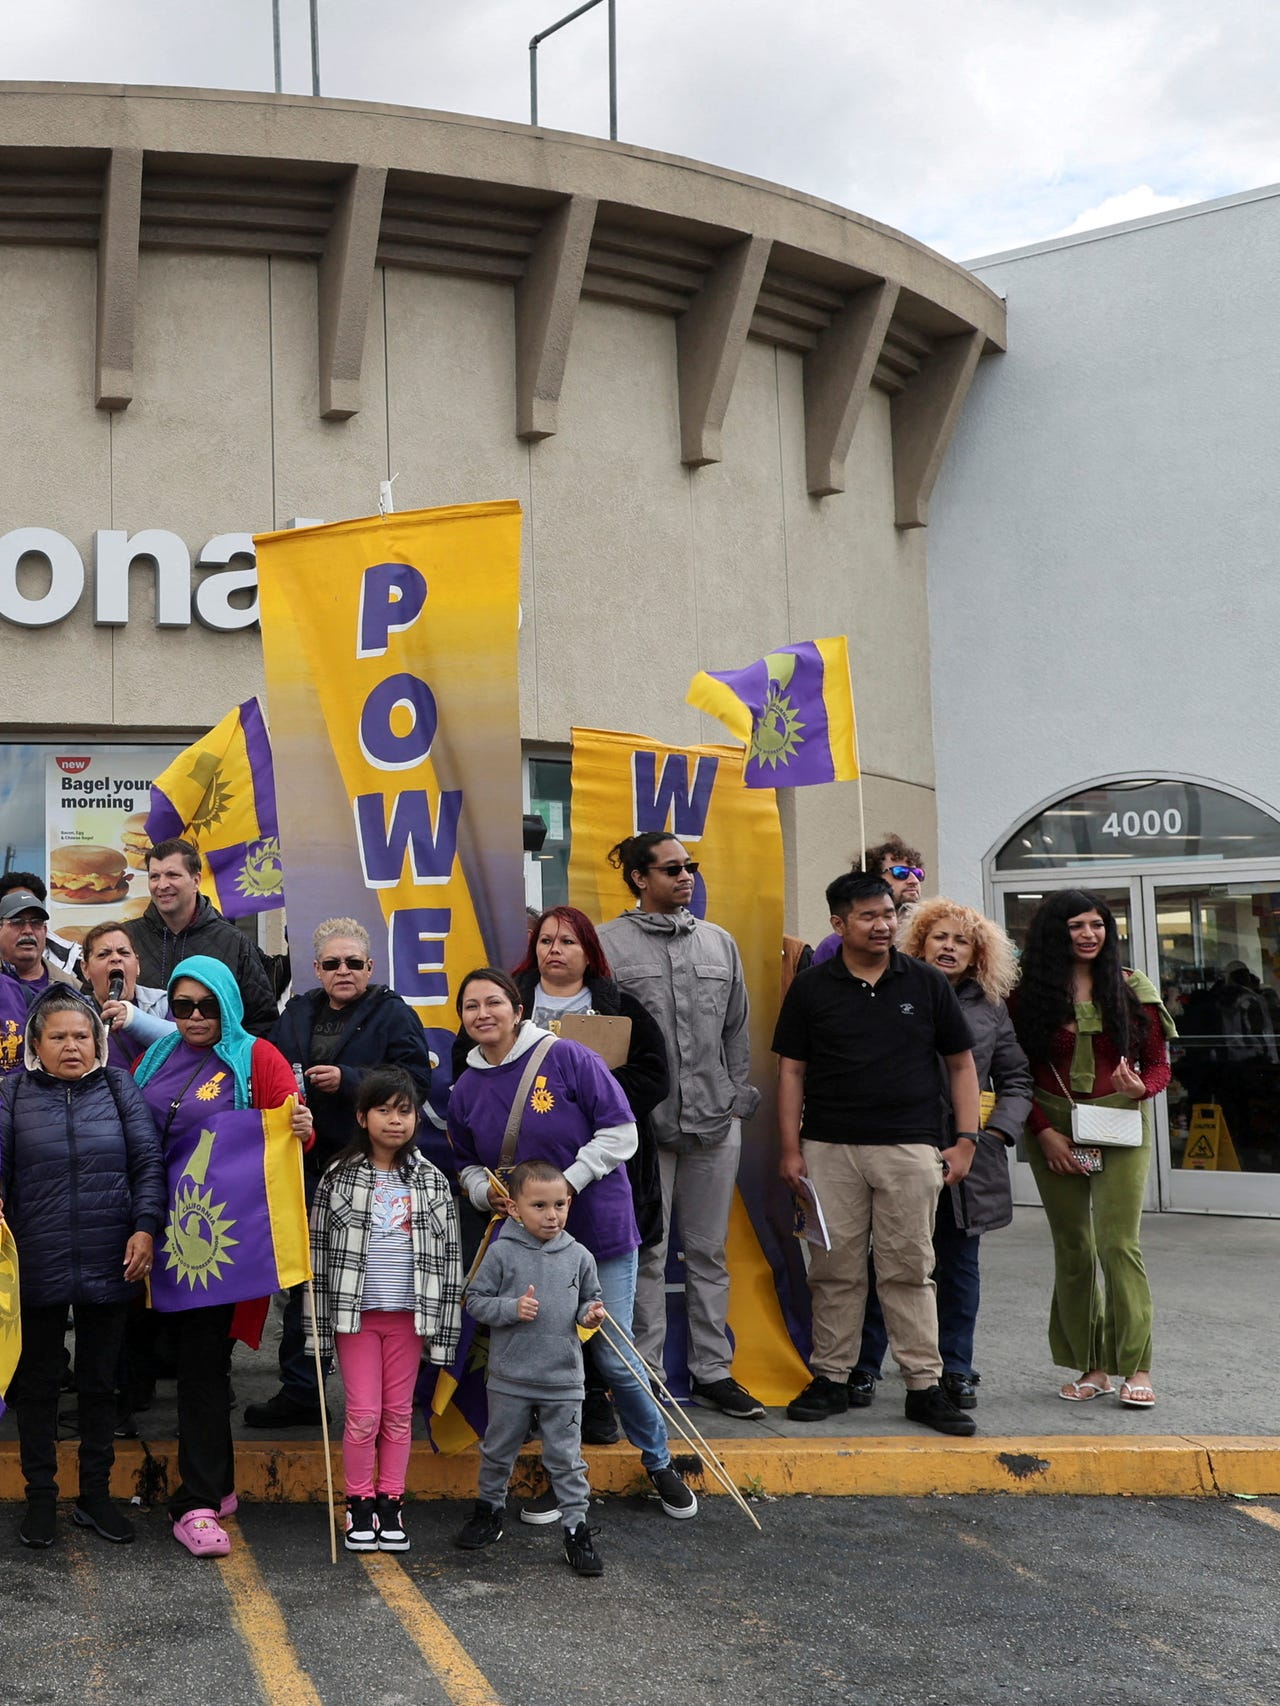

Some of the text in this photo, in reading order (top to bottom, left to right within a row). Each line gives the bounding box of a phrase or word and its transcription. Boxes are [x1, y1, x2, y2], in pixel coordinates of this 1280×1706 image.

[61, 761, 85, 769] new
[61, 776, 152, 794] Bagel your
[61, 794, 134, 812] morning
[1102, 808, 1182, 837] 4000
[182, 1202, 216, 1227] CALIFORNIA
